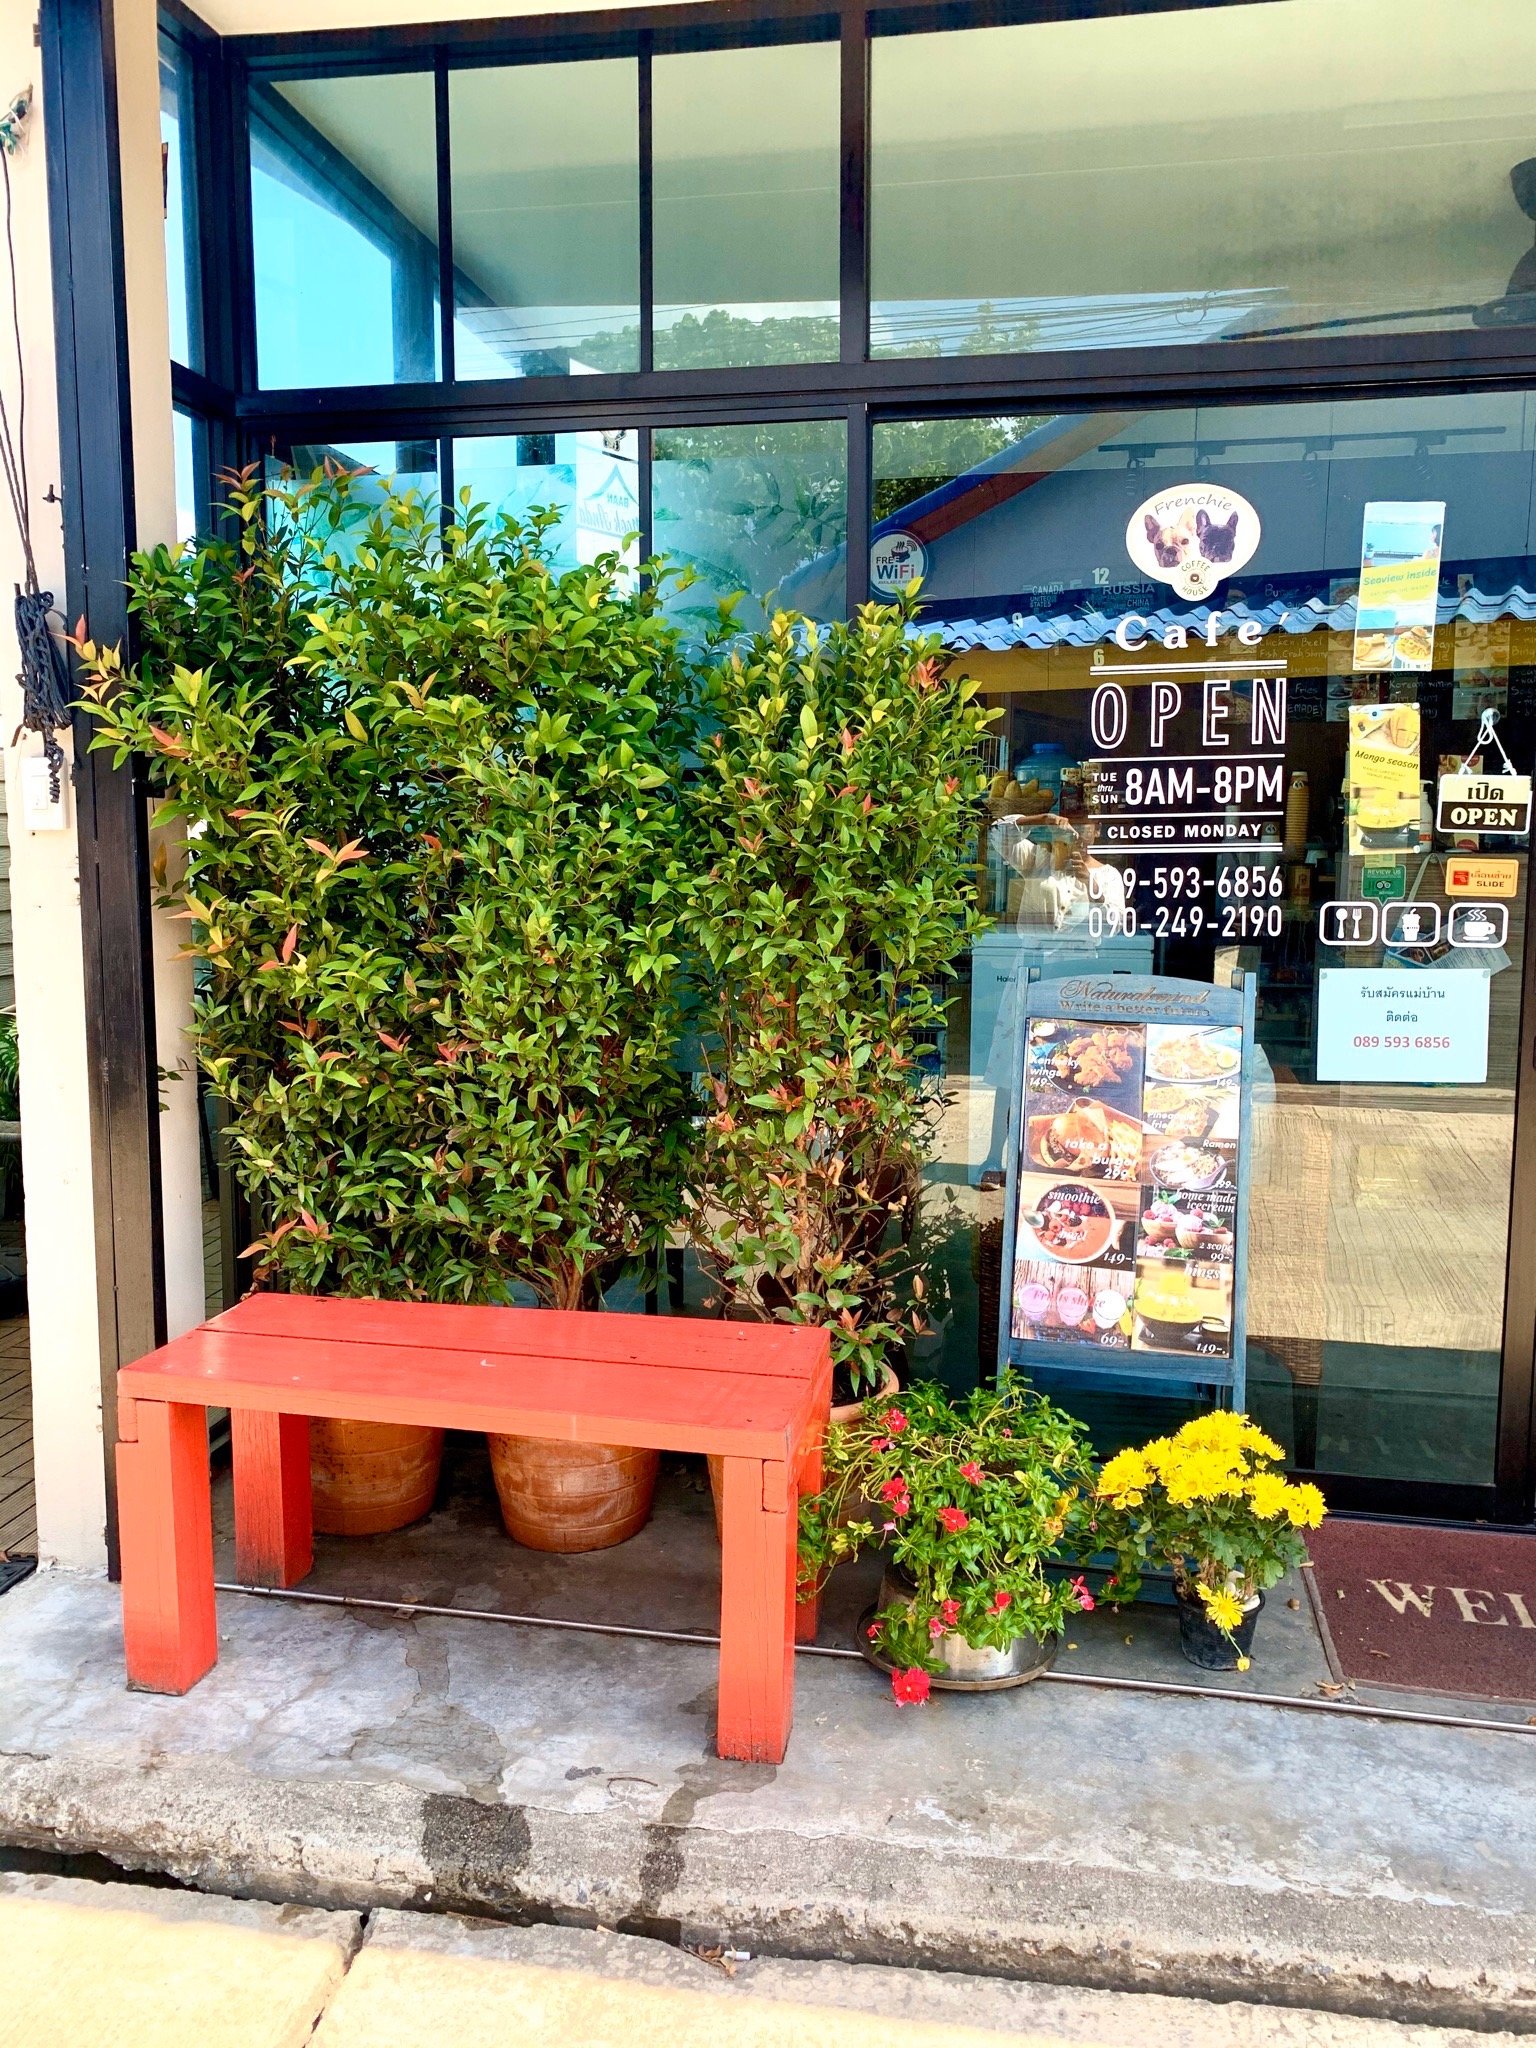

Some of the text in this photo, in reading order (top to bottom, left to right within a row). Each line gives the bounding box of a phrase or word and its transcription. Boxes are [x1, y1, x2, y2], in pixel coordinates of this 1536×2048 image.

[1154, 494, 1232, 515] Frenchie
[877, 564, 915, 580] WiFi
[1181, 560, 1211, 572] COFFEE
[1092, 567, 1110, 585] 12
[1363, 567, 1437, 586] Seaview inside
[1032, 585, 1065, 595] CANADA
[1102, 584, 1155, 595] RUSSIA
[1182, 586, 1209, 596] HOUSE
[1127, 599, 1150, 607] CHINA
[1093, 648, 1105, 666] 6
[1091, 678, 1286, 749] OPEN
[1355, 750, 1419, 770] Mango season
[1092, 772, 1117, 782] TUE
[1097, 784, 1113, 793] thru
[1125, 765, 1283, 805] 8AM-8PM
[1468, 782, 1504, 800] เปิด
[1092, 794, 1118, 804] SUN
[1451, 808, 1518, 826] OPEN
[1107, 823, 1262, 839] CLOSED MONDAY
[1089, 866, 1283, 900] 09-593-6856
[1476, 880, 1506, 888] SLIDE
[1089, 905, 1283, 938] 090-249-2190
[1360, 986, 1445, 999] รับสมัครแม่บ้าน
[1059, 1000, 1211, 1017] Write a better future
[1386, 1010, 1418, 1023] ติดต่อ
[1353, 1036, 1450, 1049] 089 593 6856
[1065, 1138, 1095, 1150] take
[1099, 1142, 1108, 1151] a
[1203, 1139, 1236, 1149] Ramen
[1048, 1191, 1102, 1205] smoothie
[1206, 1191, 1237, 1204] made
[1187, 1203, 1236, 1214] icecream
[1206, 1243, 1234, 1252] scope
[1103, 1253, 1136, 1265] 149-.
[1185, 1264, 1223, 1280] bings
[1100, 1333, 1129, 1346] 69-.
[1196, 1342, 1228, 1355] 149-.
